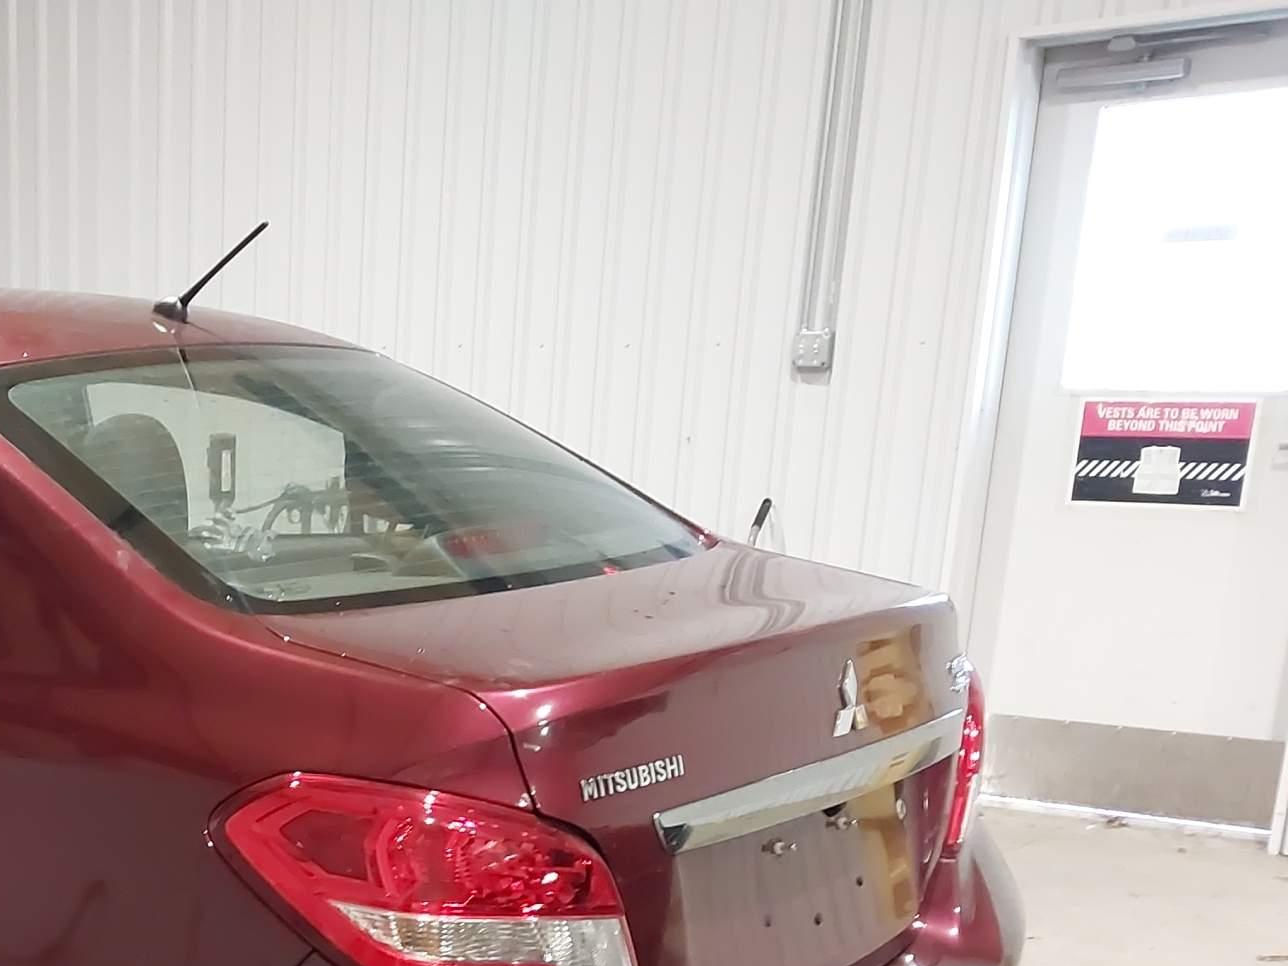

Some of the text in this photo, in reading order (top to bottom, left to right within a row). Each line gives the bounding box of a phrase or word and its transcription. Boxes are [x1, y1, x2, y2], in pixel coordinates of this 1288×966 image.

[1096, 403, 1239, 420] VESTS ARE TO BE WORN
[1107, 420, 1226, 433] BEYOND THIS POINT
[580, 755, 684, 801] MITSUBISHI
